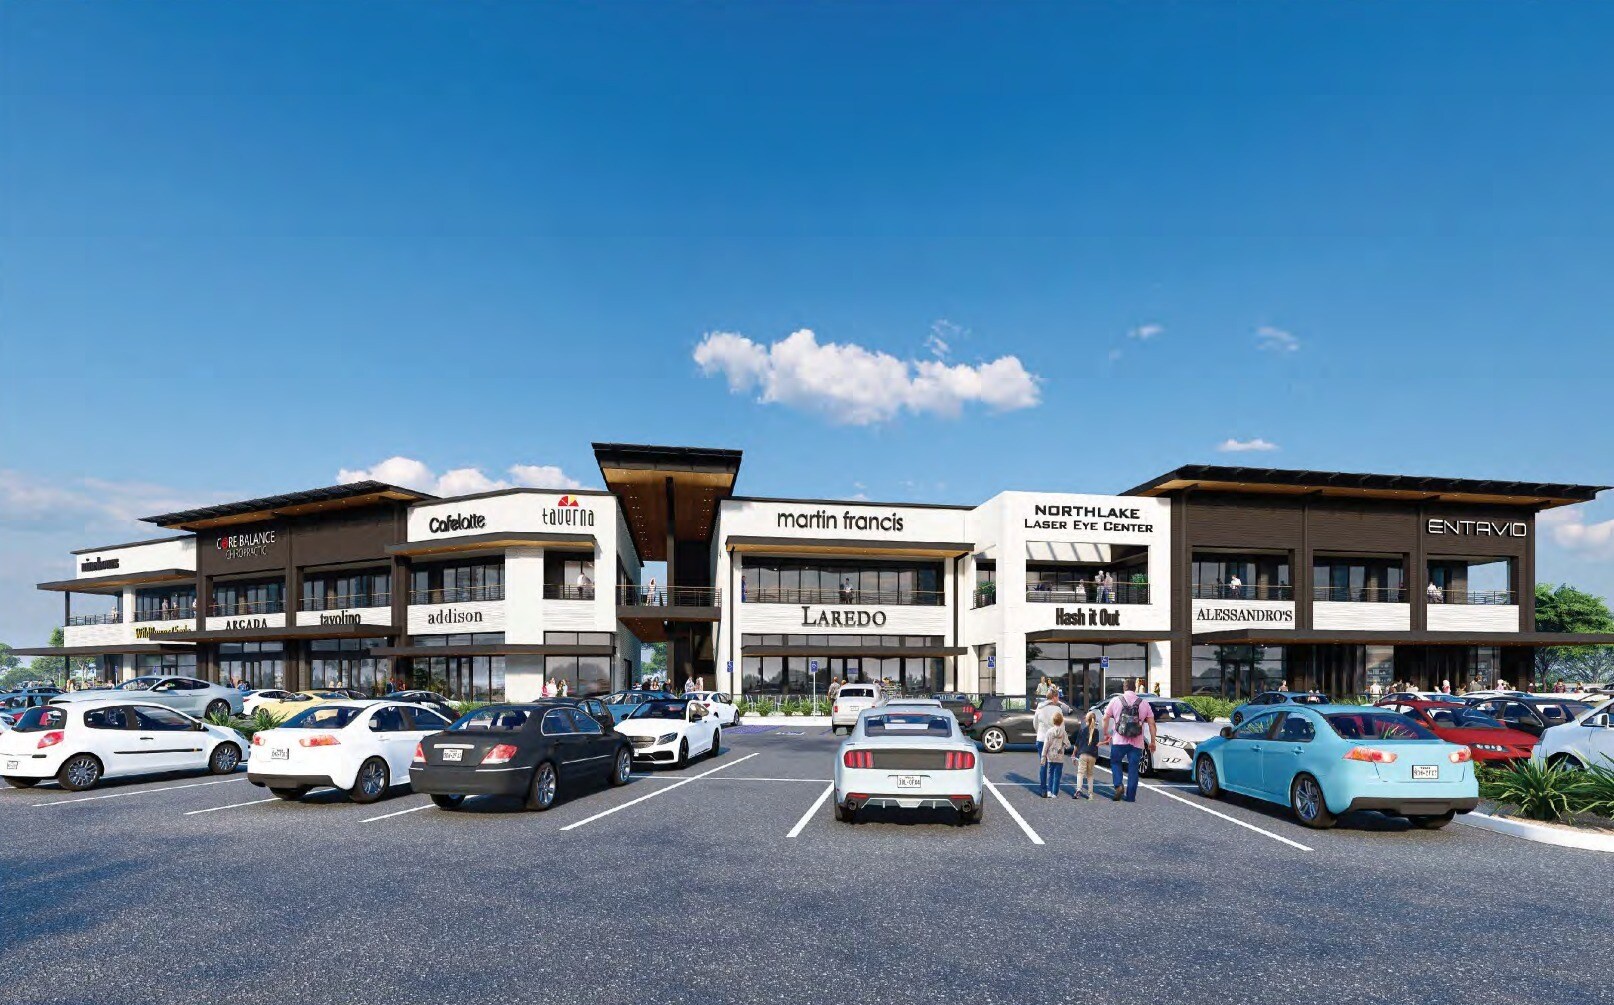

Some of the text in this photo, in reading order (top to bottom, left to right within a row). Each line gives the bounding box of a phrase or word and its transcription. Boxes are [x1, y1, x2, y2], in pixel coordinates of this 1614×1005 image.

[542, 506, 595, 527] taverna
[777, 509, 904, 532] martin francis
[1035, 504, 1141, 520] NORTHLAKE
[429, 512, 486, 534] Cafelatte
[1025, 518, 1154, 533] LASER EYE CENTER
[1428, 518, 1527, 538] ENTAVIO
[239, 530, 276, 547] BALANCE
[320, 609, 362, 626] tavolino
[428, 608, 483, 625] addison
[801, 606, 887, 628] LAREDO
[1055, 607, 1121, 627] Hash it Out
[1196, 607, 1294, 622] ALESSANDRO'S
[225, 617, 268, 630] ARCADA
